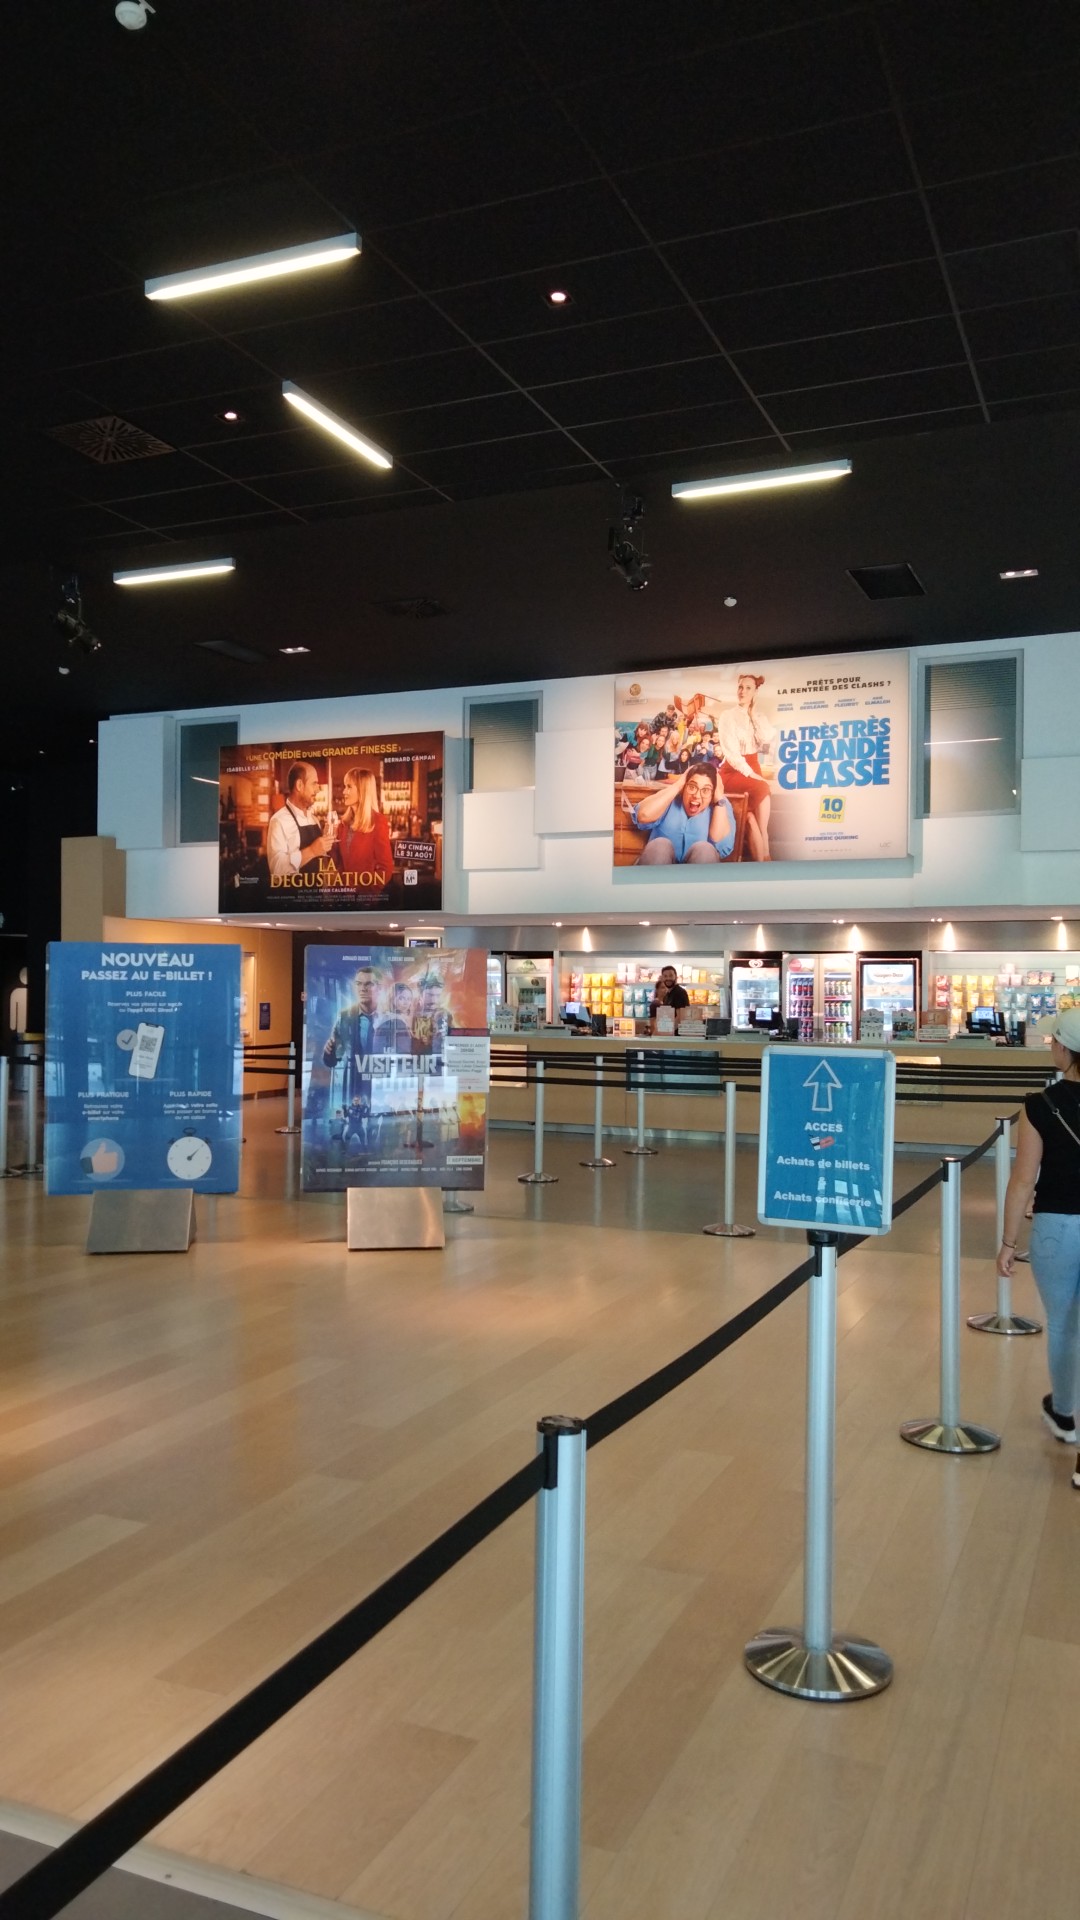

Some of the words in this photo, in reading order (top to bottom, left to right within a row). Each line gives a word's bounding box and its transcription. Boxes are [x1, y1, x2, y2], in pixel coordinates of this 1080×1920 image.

[790, 685, 829, 694] RENTRÉE
[851, 680, 885, 689] CLASHS
[807, 678, 834, 686] PRÊTS
[837, 676, 861, 684] POUR
[780, 729, 797, 742] LA
[798, 722, 838, 741] TRÈS
[840, 715, 890, 739] TRÈS
[262, 749, 301, 760] COMÉDIE
[302, 750, 321, 758] D'UNE
[322, 746, 359, 757] GRANDE
[360, 743, 398, 754] FINESSE
[778, 736, 890, 763] GRANDE
[411, 754, 436, 762] CAMPAN
[777, 758, 890, 790] CLASSE
[822, 798, 843, 812] 10
[408, 844, 433, 852] CINÉMA
[414, 851, 433, 859] AOÛT
[319, 858, 337, 872] LA
[101, 952, 194, 967] NOUVEAU
[81, 970, 128, 981] PASSEZ
[131, 971, 148, 981] AU
[153, 971, 205, 981] E-BILLET
[804, 1121, 843, 1133] ACCES
[776, 1155, 815, 1167] Achats
[818, 1158, 832, 1168] de
[834, 1159, 871, 1171] billets
[774, 1190, 812, 1203] Achats
[815, 1195, 872, 1208] confiserie
